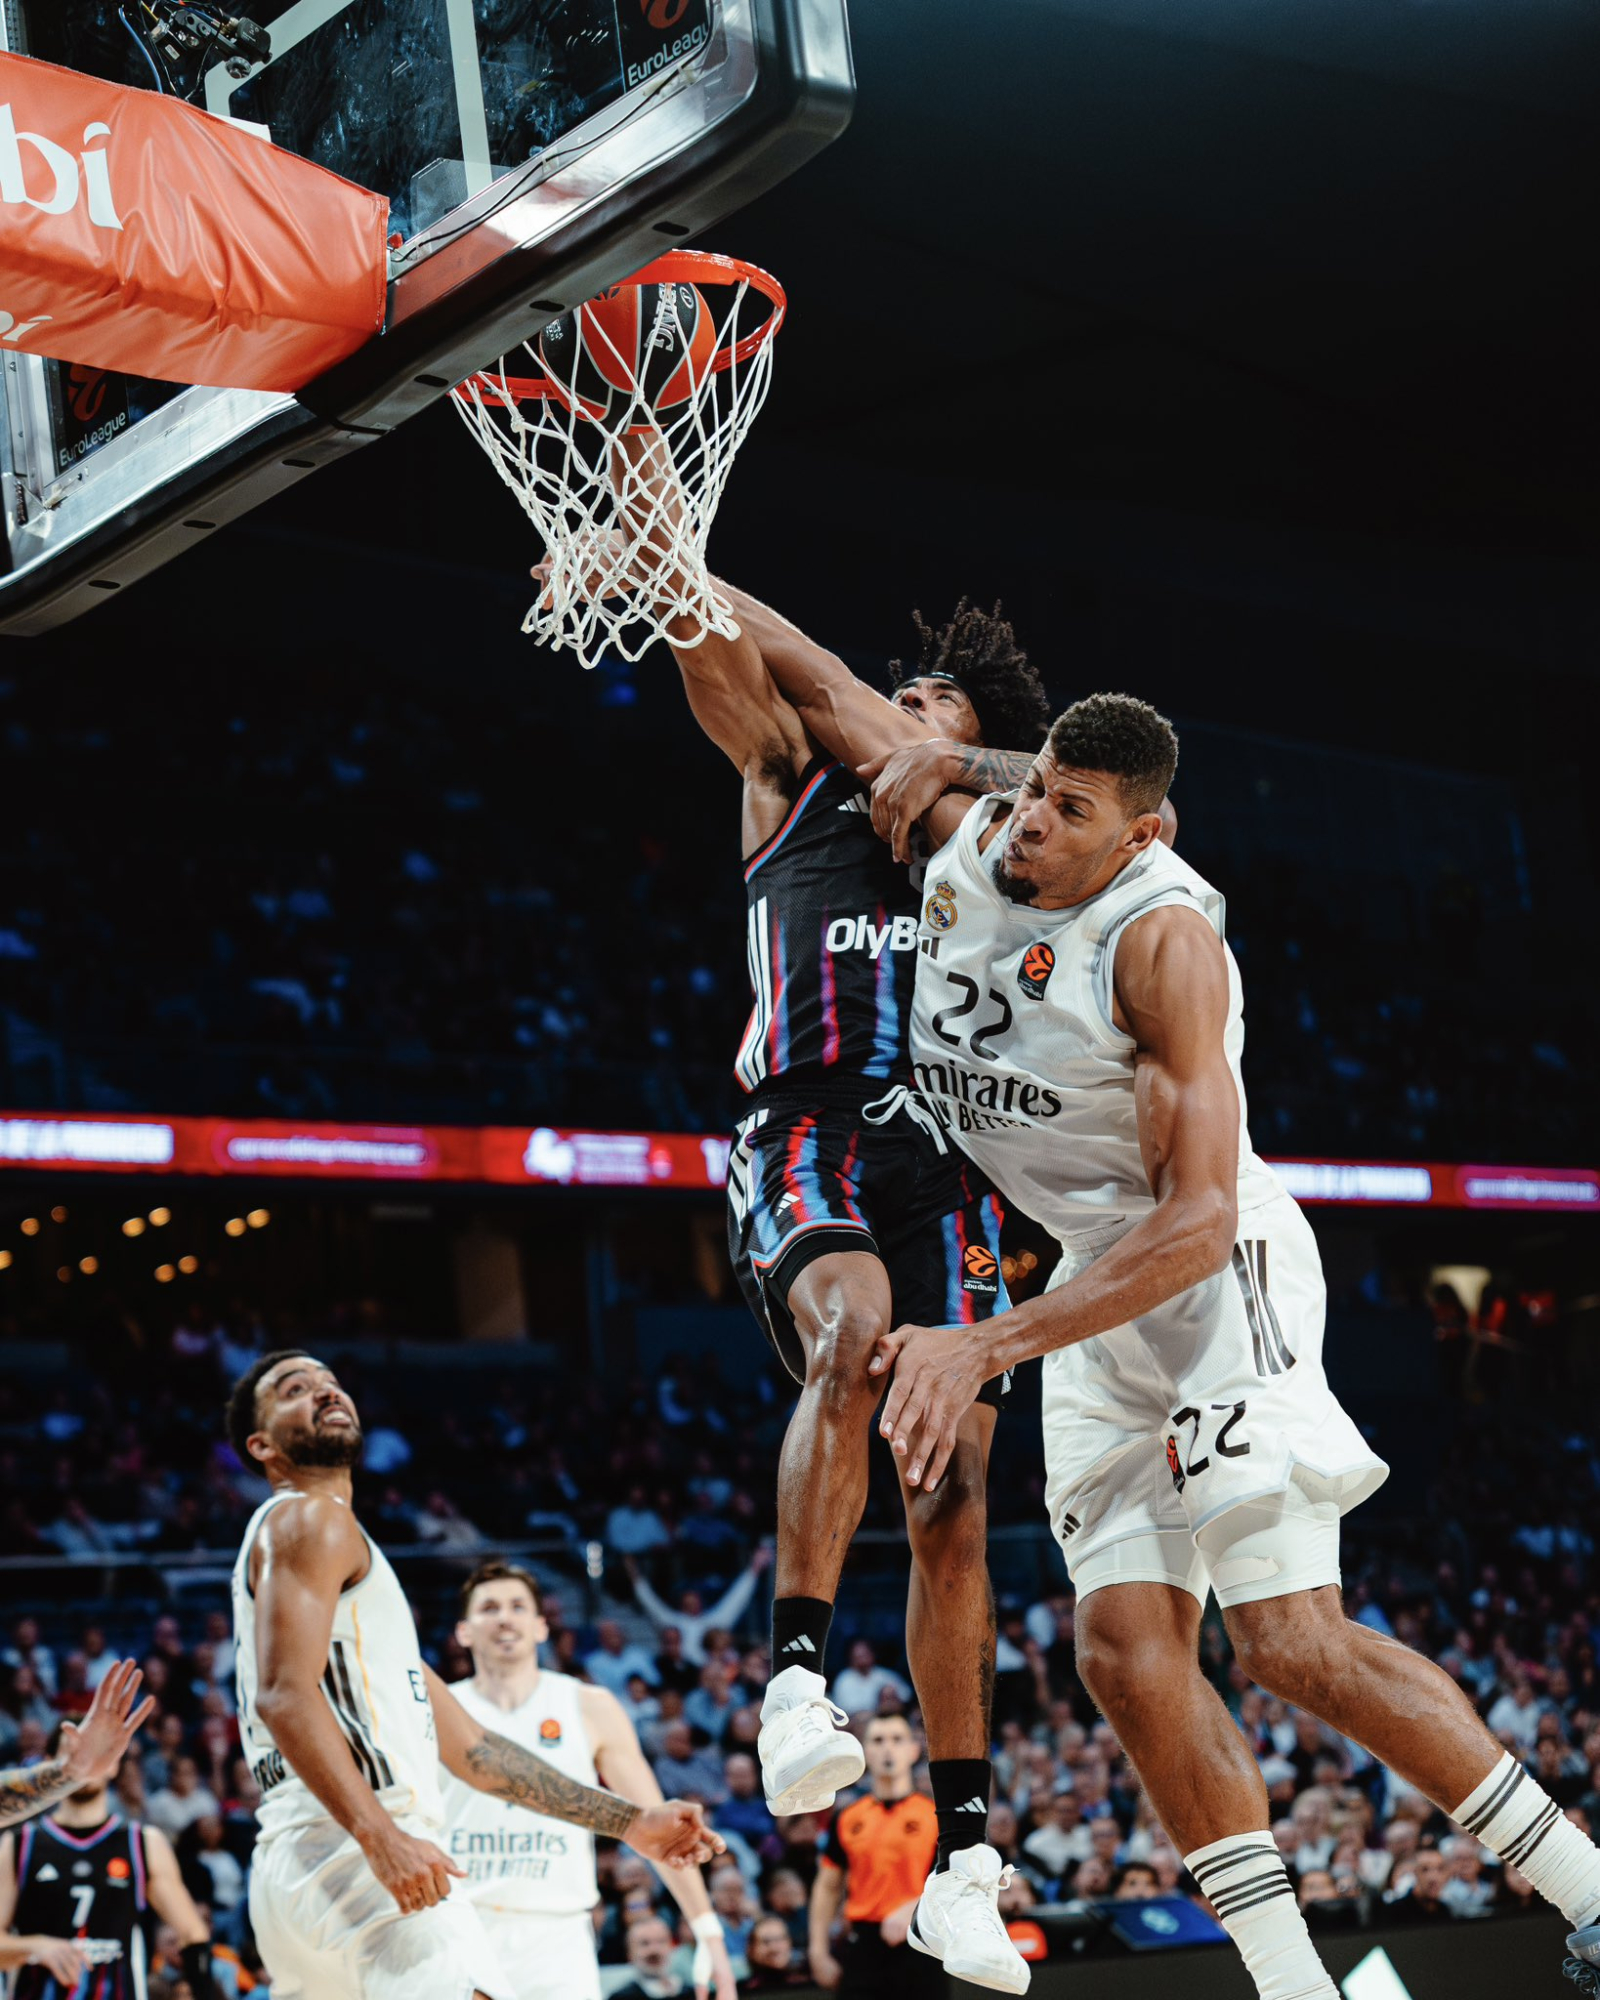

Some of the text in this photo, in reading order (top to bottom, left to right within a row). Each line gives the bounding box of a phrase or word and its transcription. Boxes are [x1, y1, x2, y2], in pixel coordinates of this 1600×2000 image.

[60, 411, 126, 467] EuroLeague
[932, 971, 1012, 1062] 22
[1172, 1400, 1250, 1476] 22
[69, 1884, 96, 1929] 7
